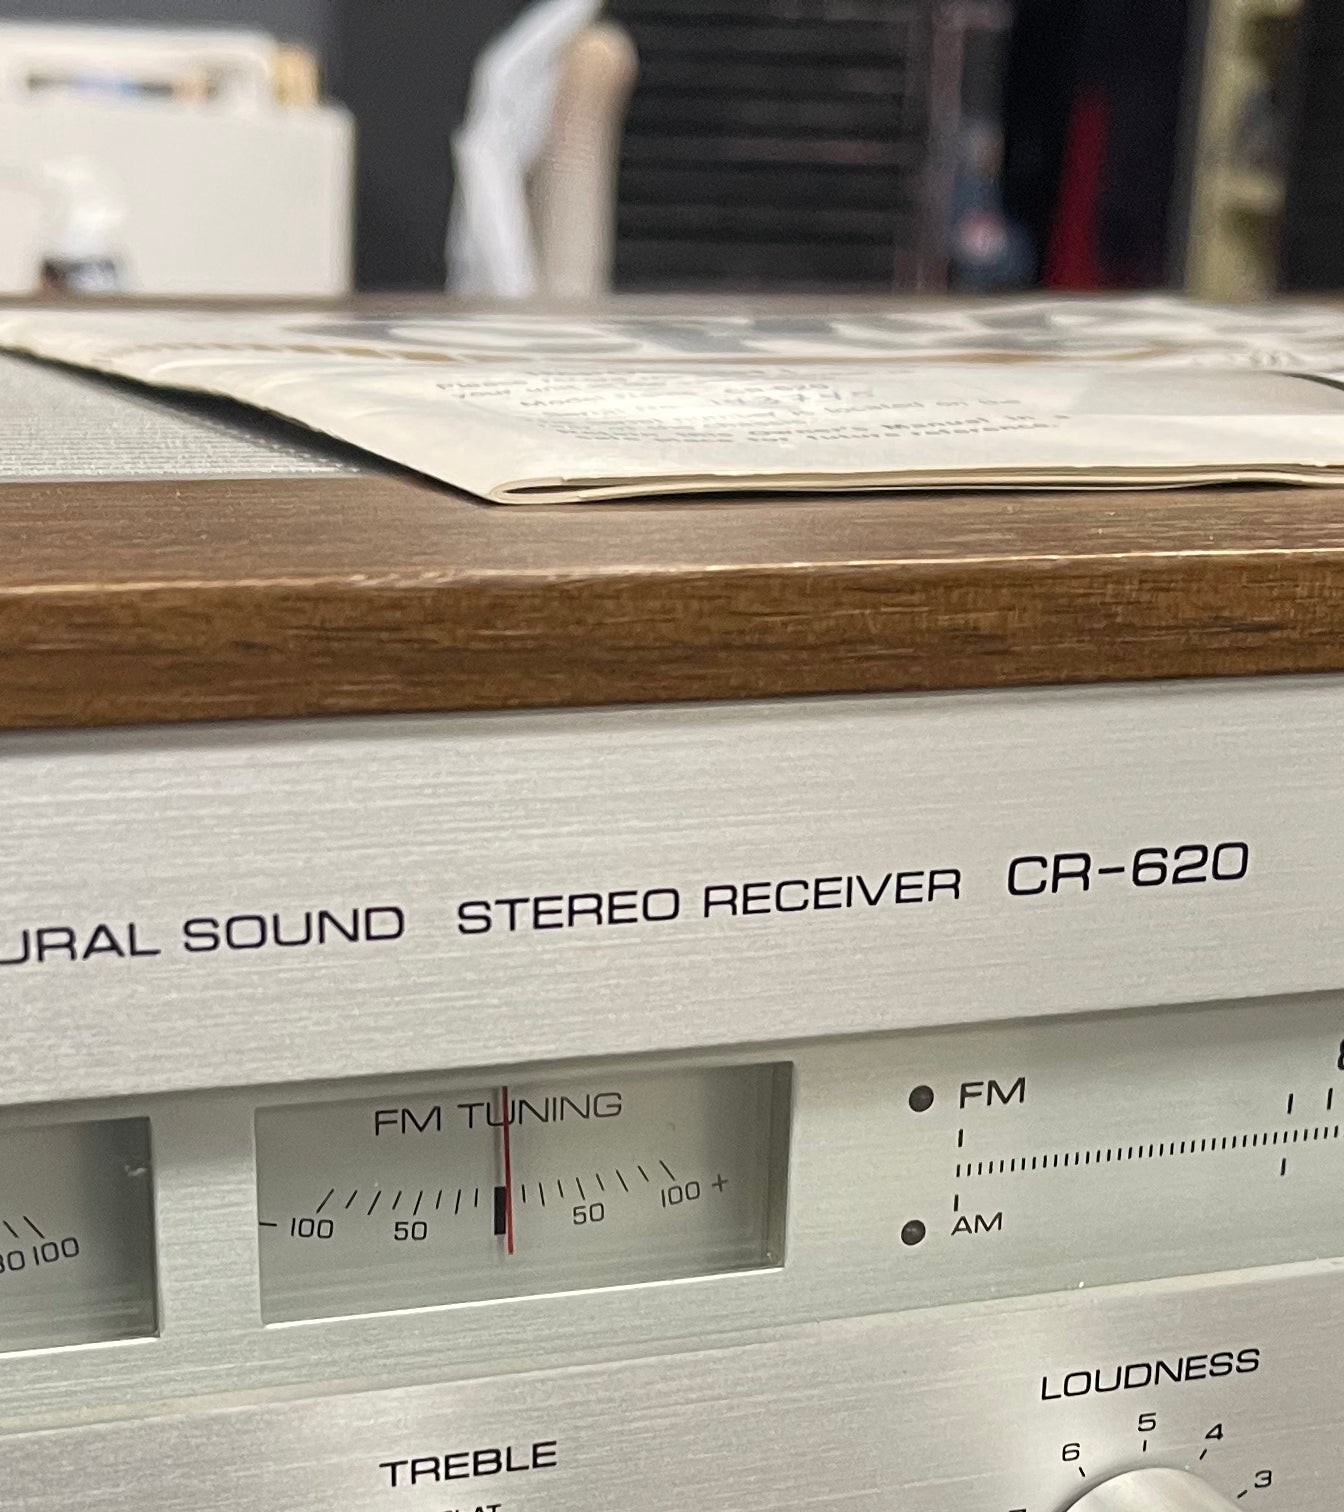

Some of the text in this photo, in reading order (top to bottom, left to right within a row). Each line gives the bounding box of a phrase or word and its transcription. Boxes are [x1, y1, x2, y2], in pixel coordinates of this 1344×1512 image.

[183, 906, 405, 953] SOUND
[457, 888, 680, 935] STEREO
[703, 868, 961, 918] RECEIVER
[1007, 841, 1249, 896] CR-620
[959, 1076, 1026, 1109] FM
[374, 1092, 622, 1137] FM TUNING
[290, 1181, 701, 1241] 100 50 50 100
[950, 1212, 1003, 1236] AM
[32, 1236, 80, 1266] 100
[1041, 1348, 1260, 1401] LOUDNESS
[1137, 1412, 1157, 1432] 5
[1204, 1423, 1224, 1440] 4
[378, 1440, 557, 1488] TREBLE
[1062, 1442, 1081, 1462] 6
[1254, 1470, 1273, 1489] 3
